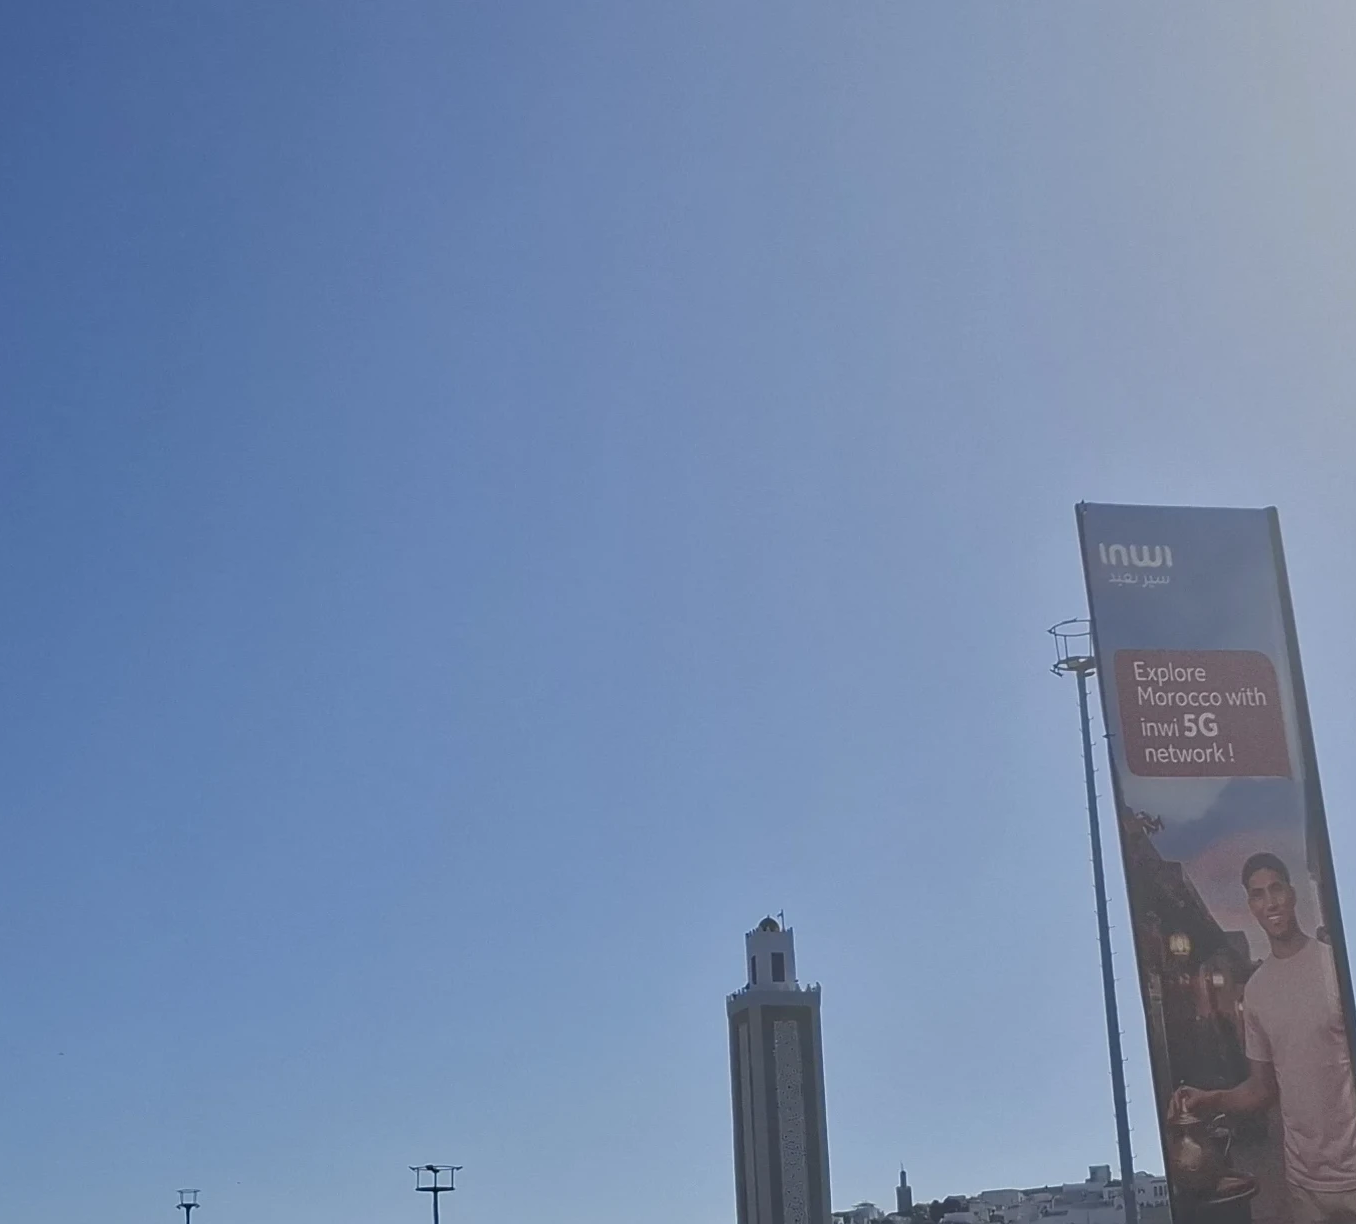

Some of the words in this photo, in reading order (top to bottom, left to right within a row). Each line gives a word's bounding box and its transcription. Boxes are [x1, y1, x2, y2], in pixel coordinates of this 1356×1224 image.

[1099, 543, 1173, 568] inwi
[1133, 661, 1206, 687] Explore
[1137, 686, 1222, 706] Morocco
[1226, 687, 1267, 706] with
[1141, 718, 1179, 737] inwi
[1183, 712, 1218, 737] 5G
[1145, 742, 1225, 763] network
